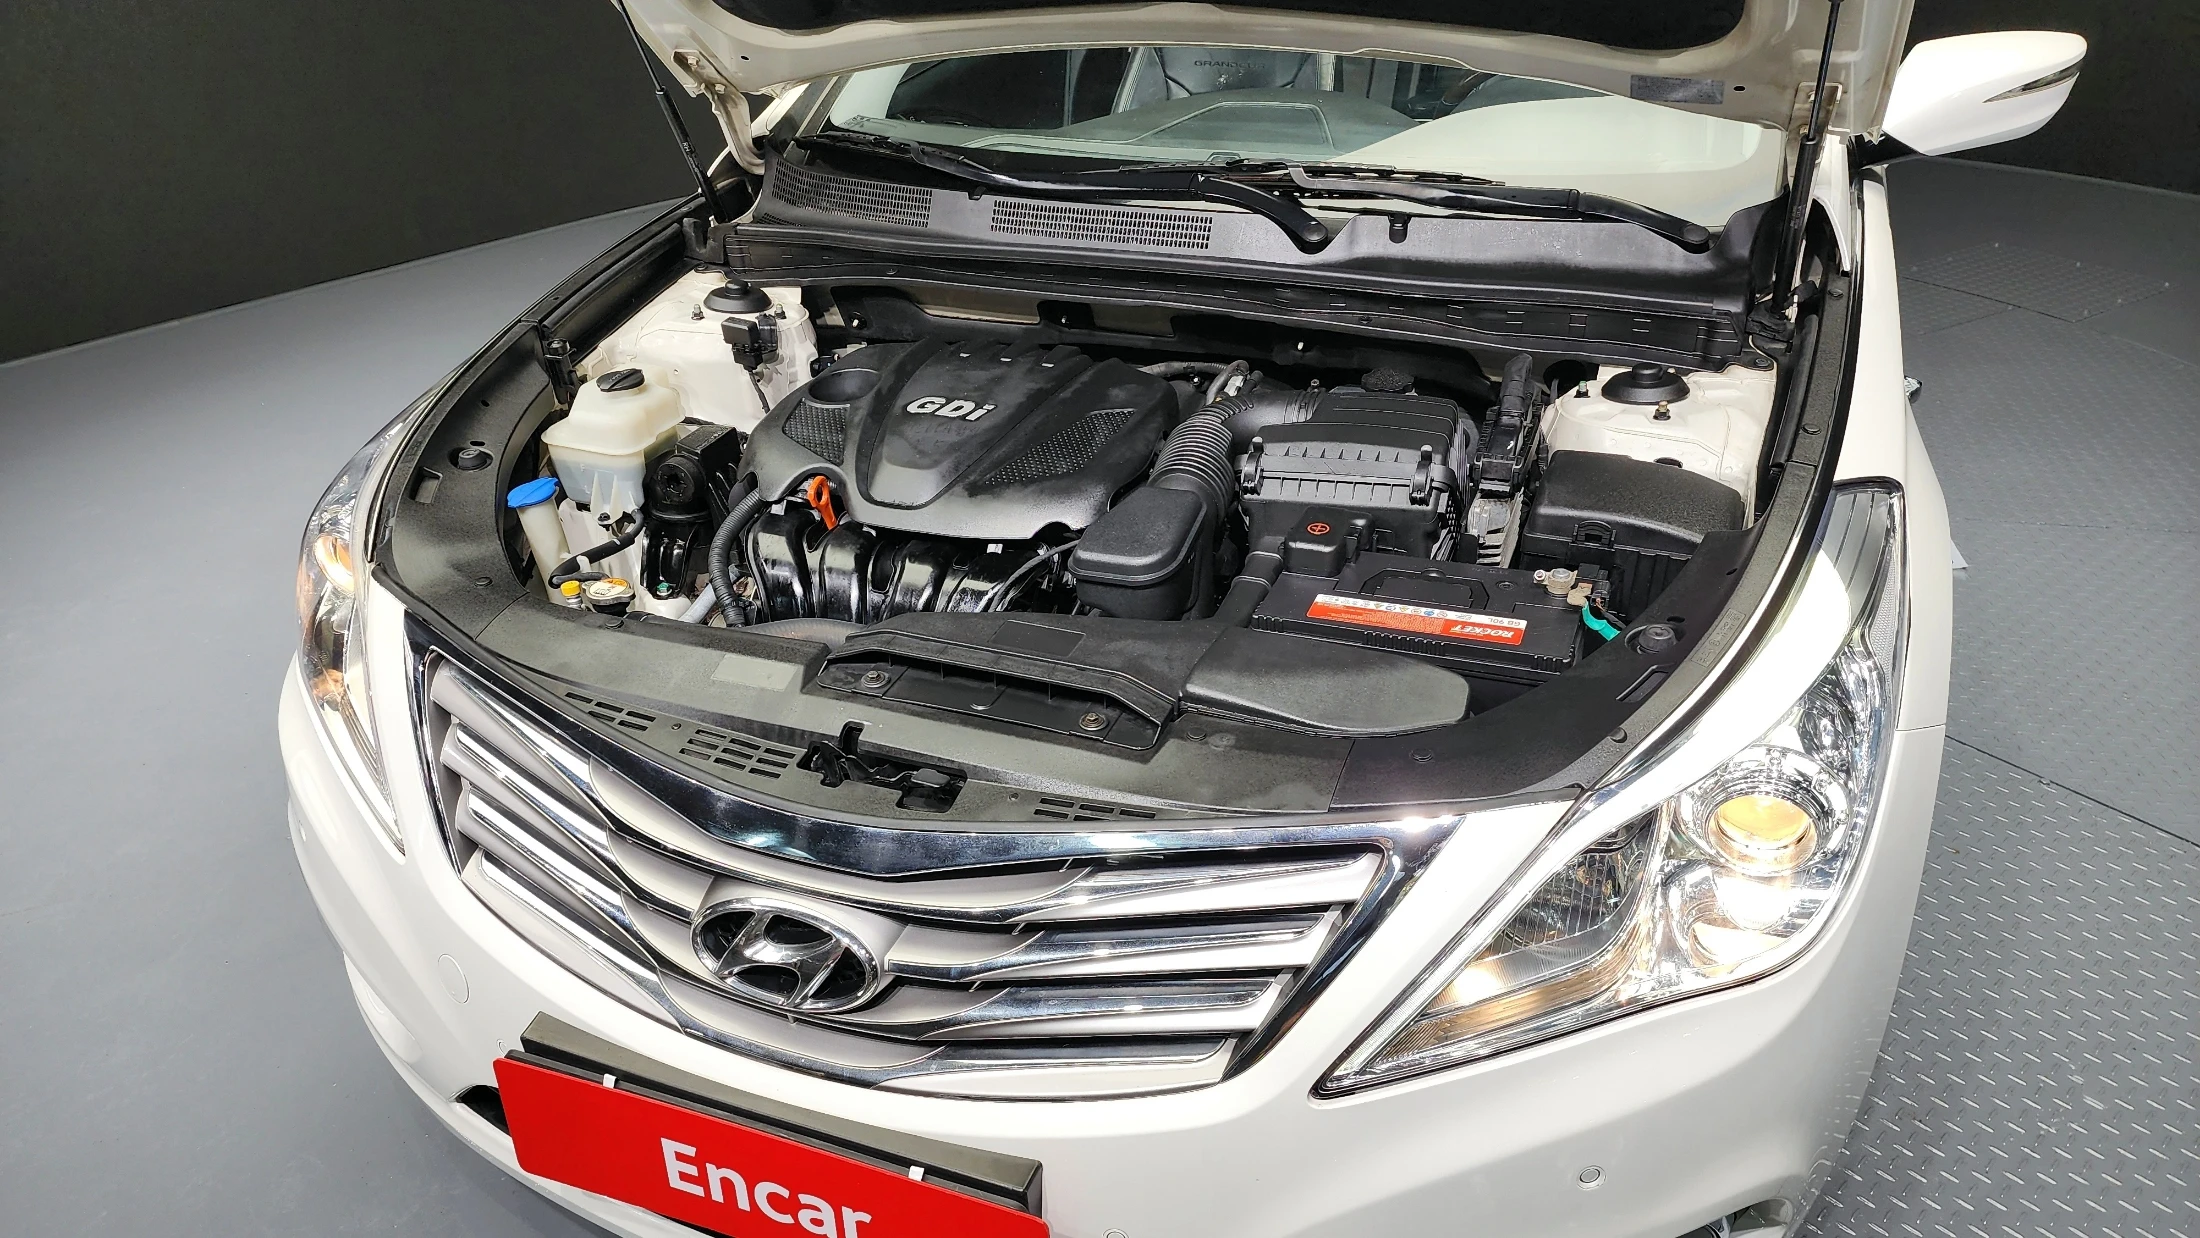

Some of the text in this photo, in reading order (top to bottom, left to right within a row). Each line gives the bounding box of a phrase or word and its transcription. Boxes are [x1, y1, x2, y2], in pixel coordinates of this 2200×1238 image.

[906, 396, 997, 421] GDi
[1449, 624, 1515, 639] ROCKET
[660, 1137, 873, 1238] Encar
